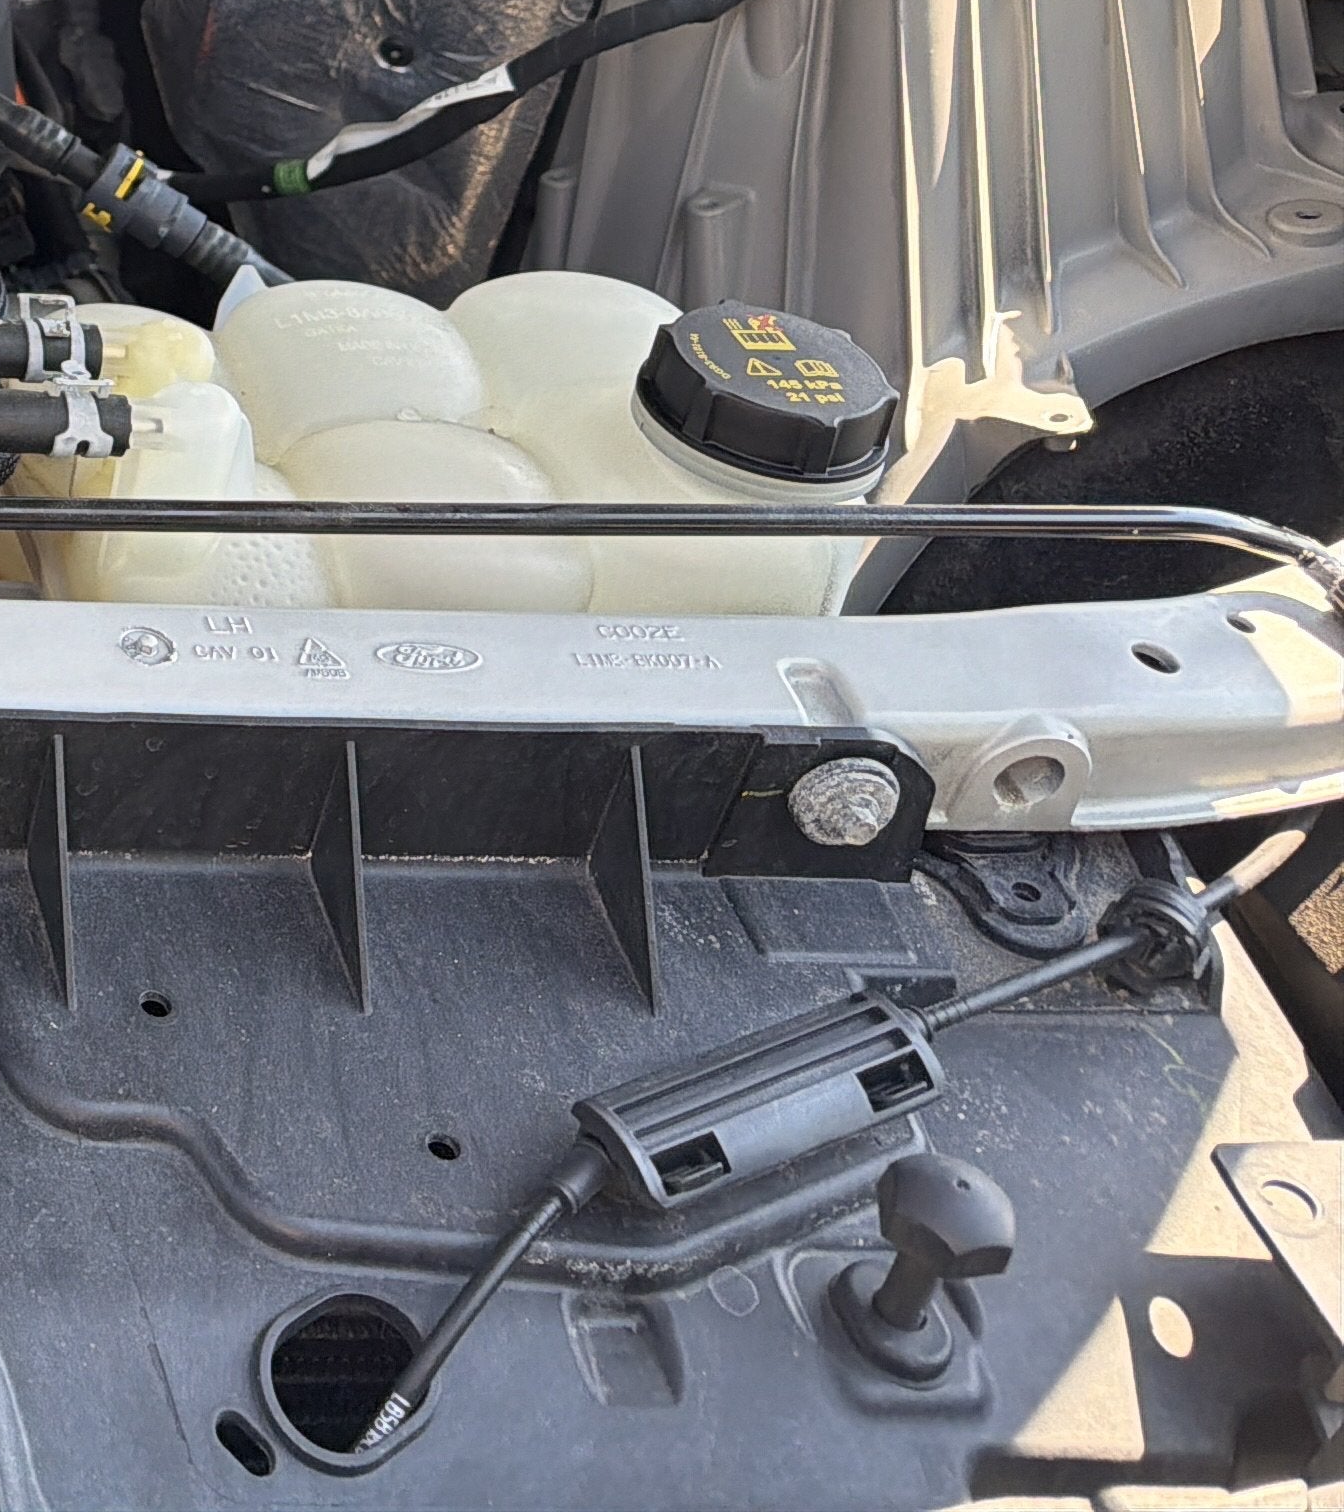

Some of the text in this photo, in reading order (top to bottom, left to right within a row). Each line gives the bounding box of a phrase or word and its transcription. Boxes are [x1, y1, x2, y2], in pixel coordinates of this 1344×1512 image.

[767, 379, 844, 390] 145 kPa
[785, 392, 845, 404] 21 psi
[204, 616, 253, 635] LH
[390, 644, 470, 670] Ford
